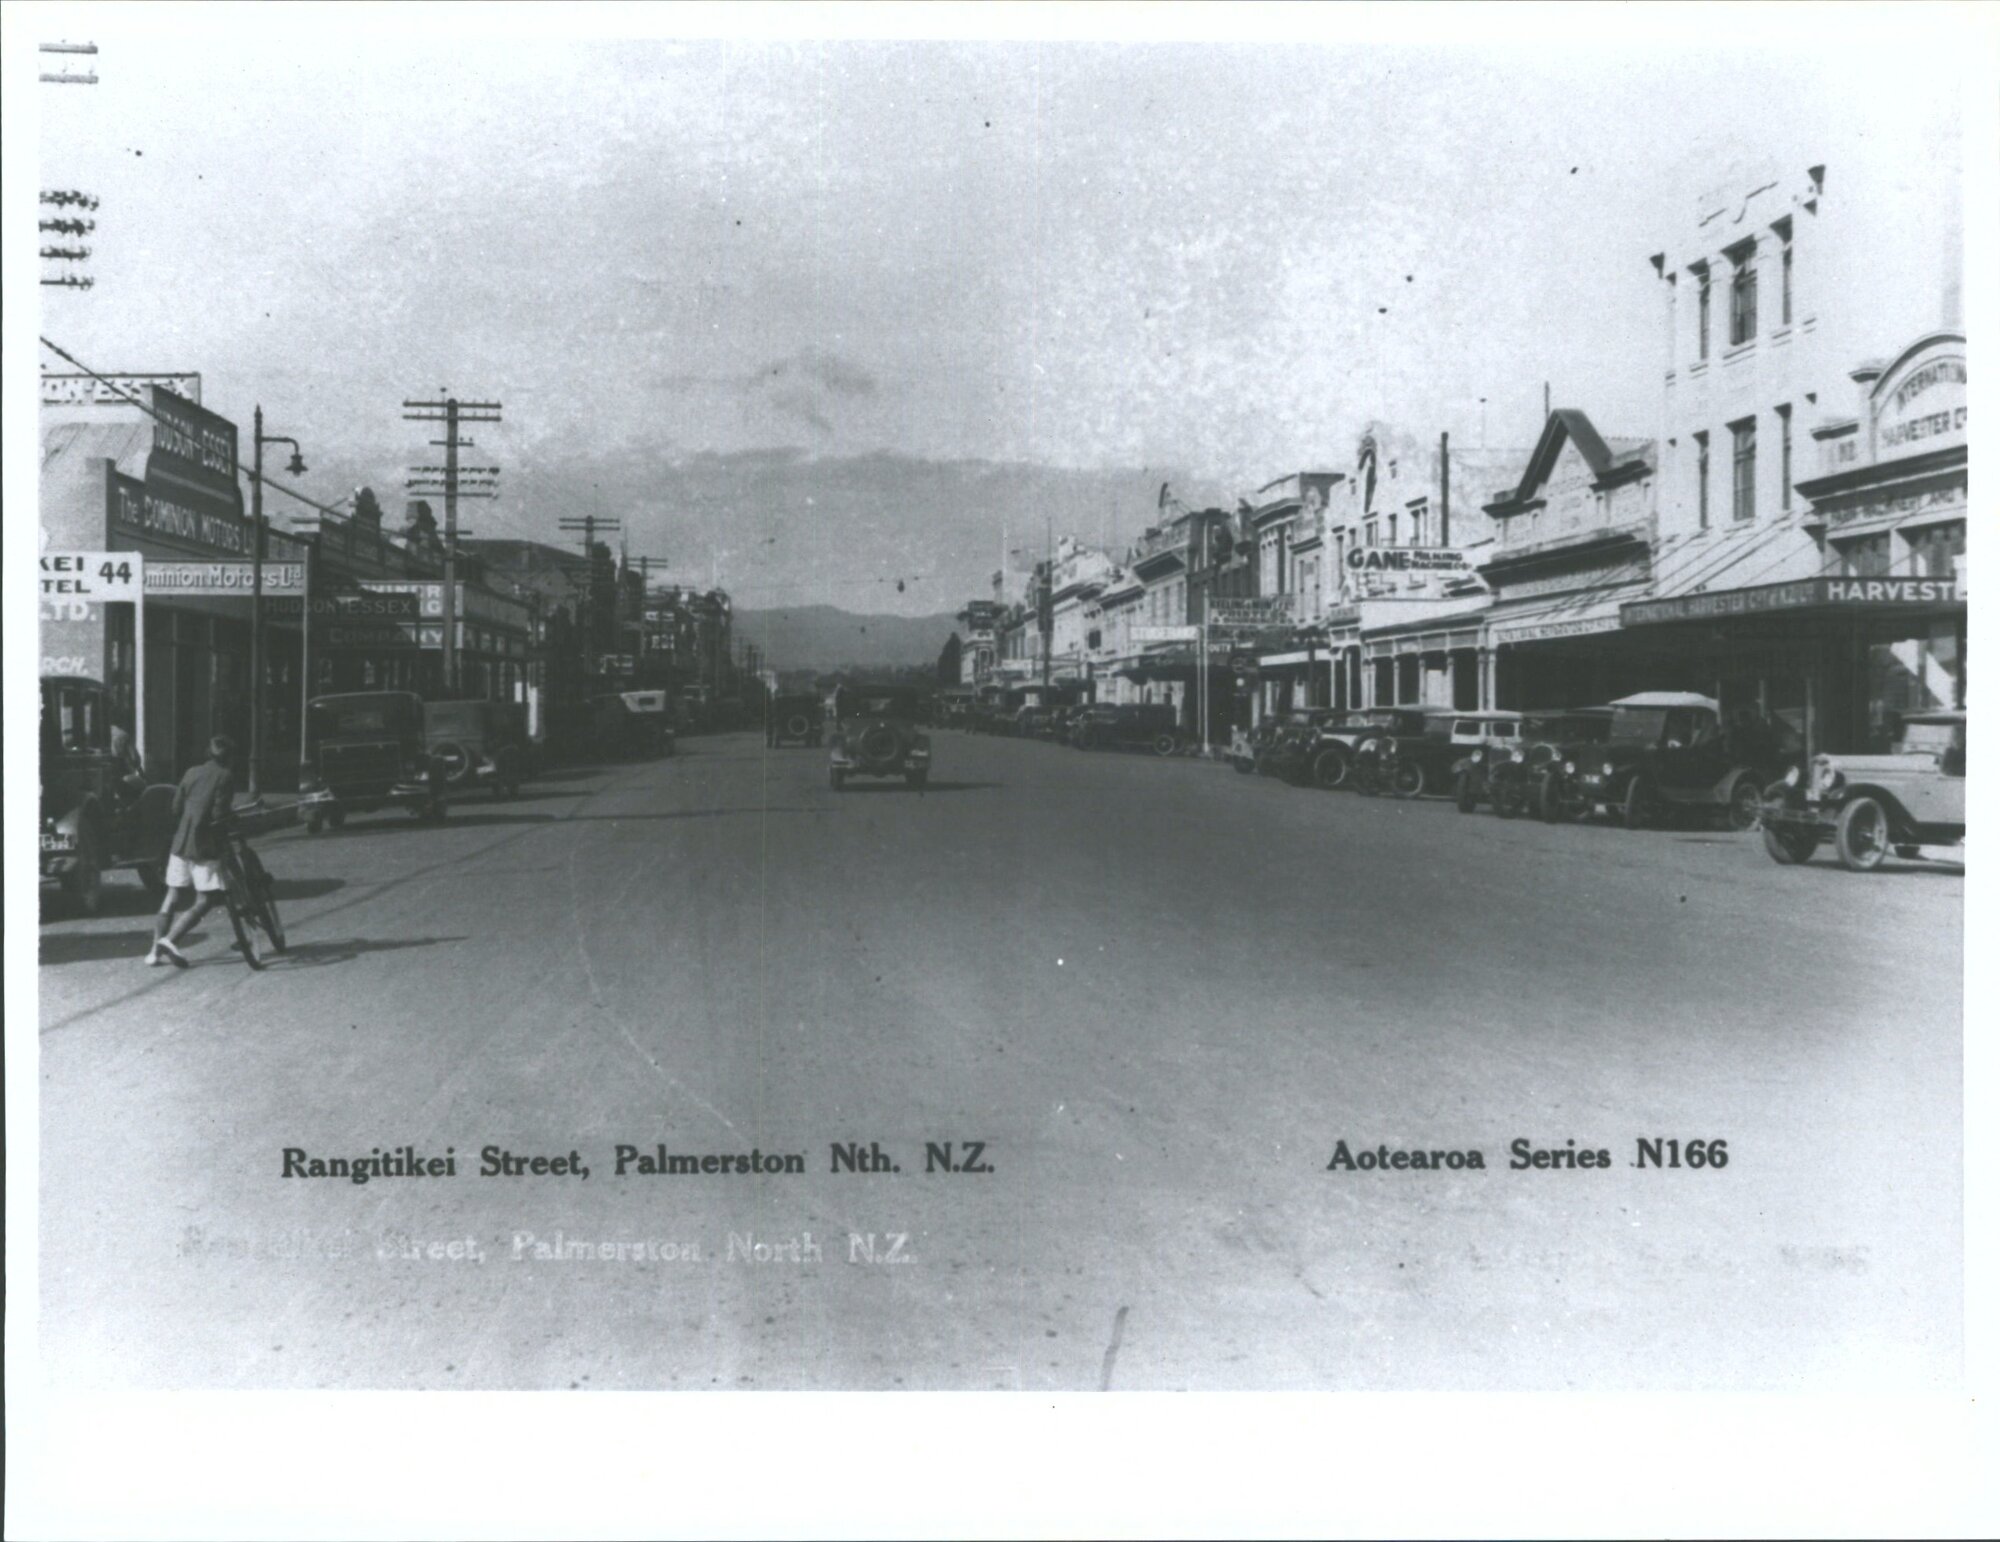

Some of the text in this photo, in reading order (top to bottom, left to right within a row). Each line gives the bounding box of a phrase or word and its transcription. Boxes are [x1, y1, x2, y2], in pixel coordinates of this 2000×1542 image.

[144, 495, 197, 541] DOMINION
[1347, 548, 1411, 570] GANE
[99, 561, 132, 584] 44
[41, 580, 91, 593] TEL
